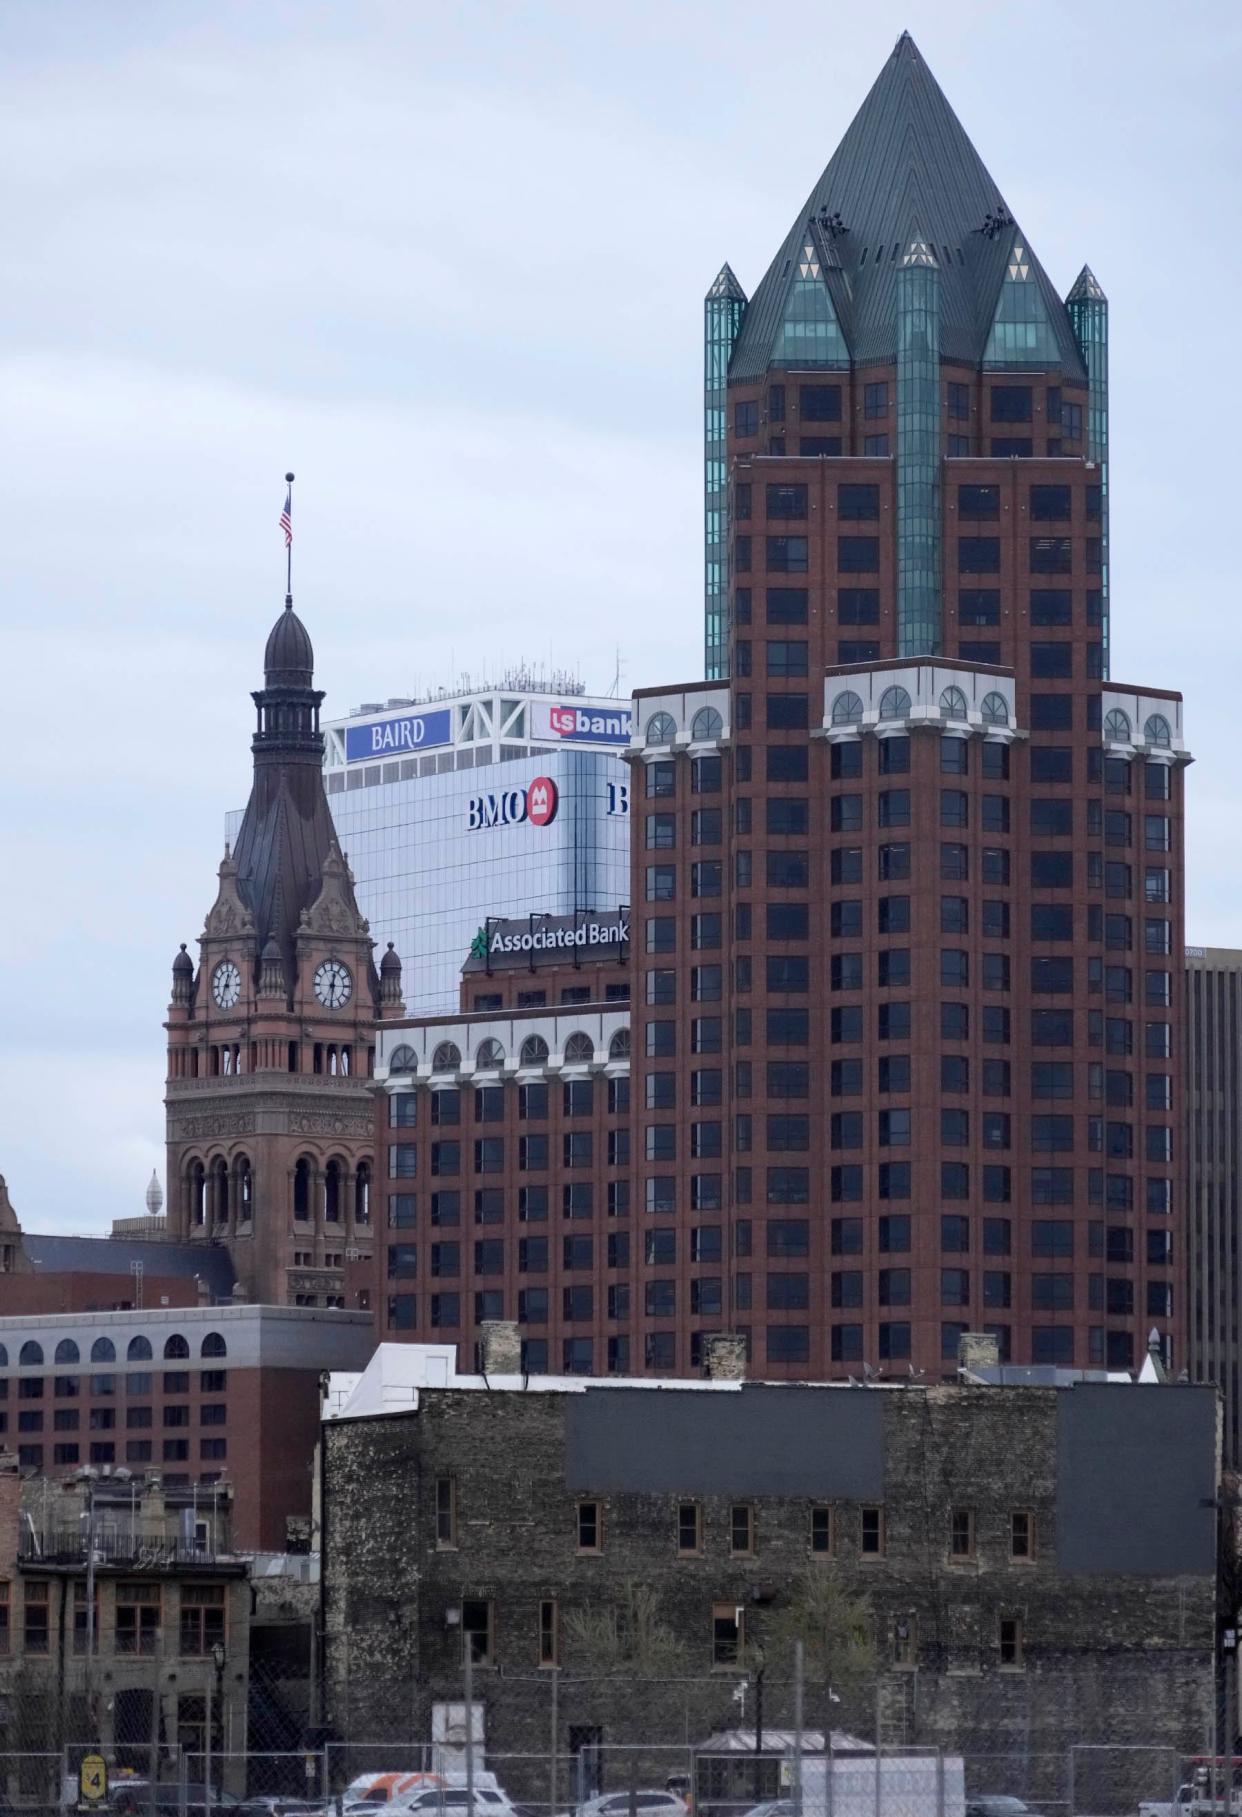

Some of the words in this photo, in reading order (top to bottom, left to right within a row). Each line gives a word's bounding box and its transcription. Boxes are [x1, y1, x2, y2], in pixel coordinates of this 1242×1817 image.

[371, 718, 425, 751] BAIRD
[465, 788, 528, 832] BMO
[489, 923, 587, 953] Associated
[588, 919, 630, 945] Bank
